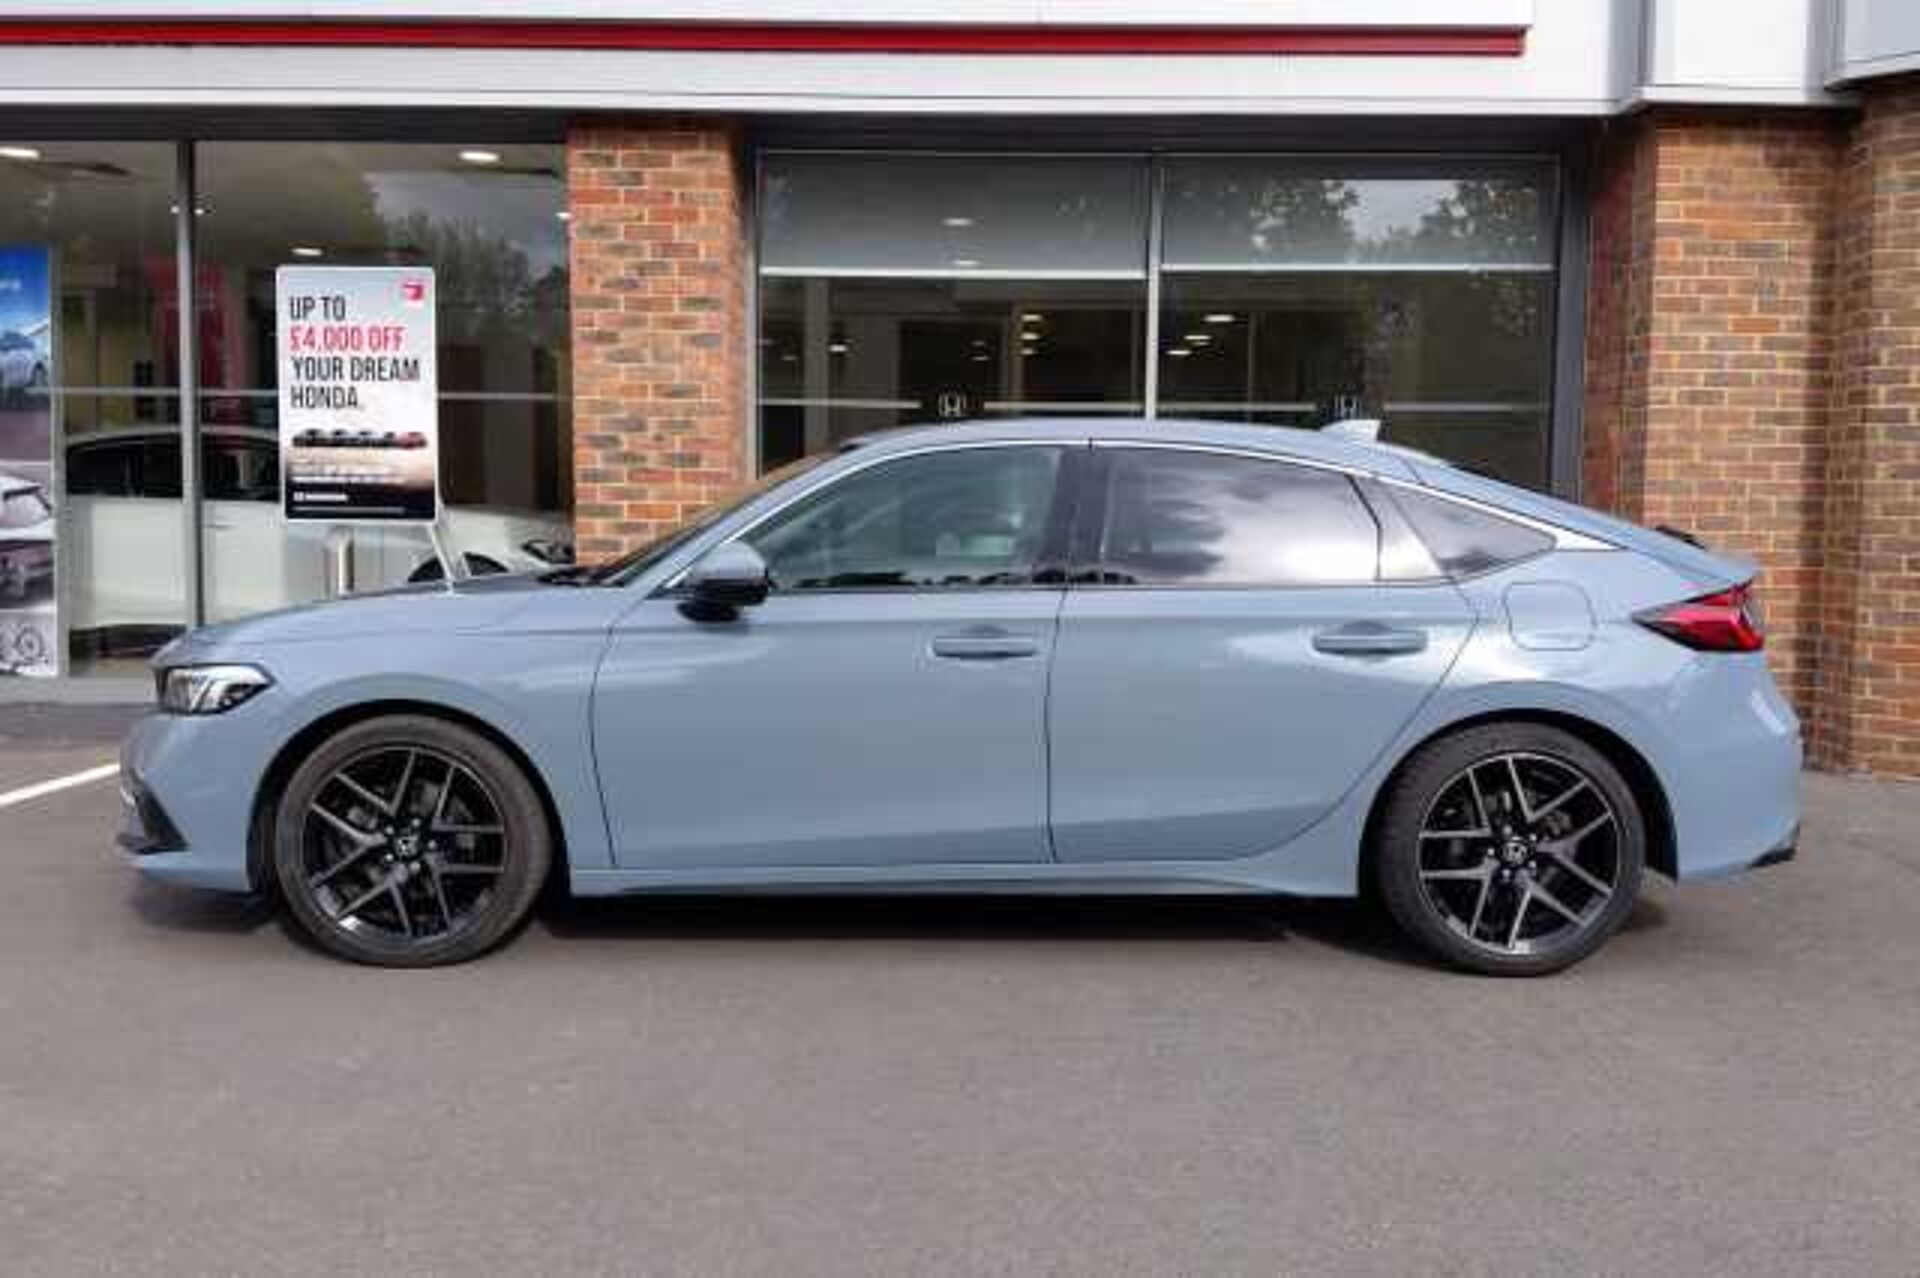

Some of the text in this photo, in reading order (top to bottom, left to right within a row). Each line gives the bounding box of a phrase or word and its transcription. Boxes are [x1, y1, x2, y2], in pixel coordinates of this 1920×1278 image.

[289, 295, 346, 320] UP TO
[289, 325, 405, 352] £4,000 OFF
[290, 356, 420, 381] YOUR DREAM
